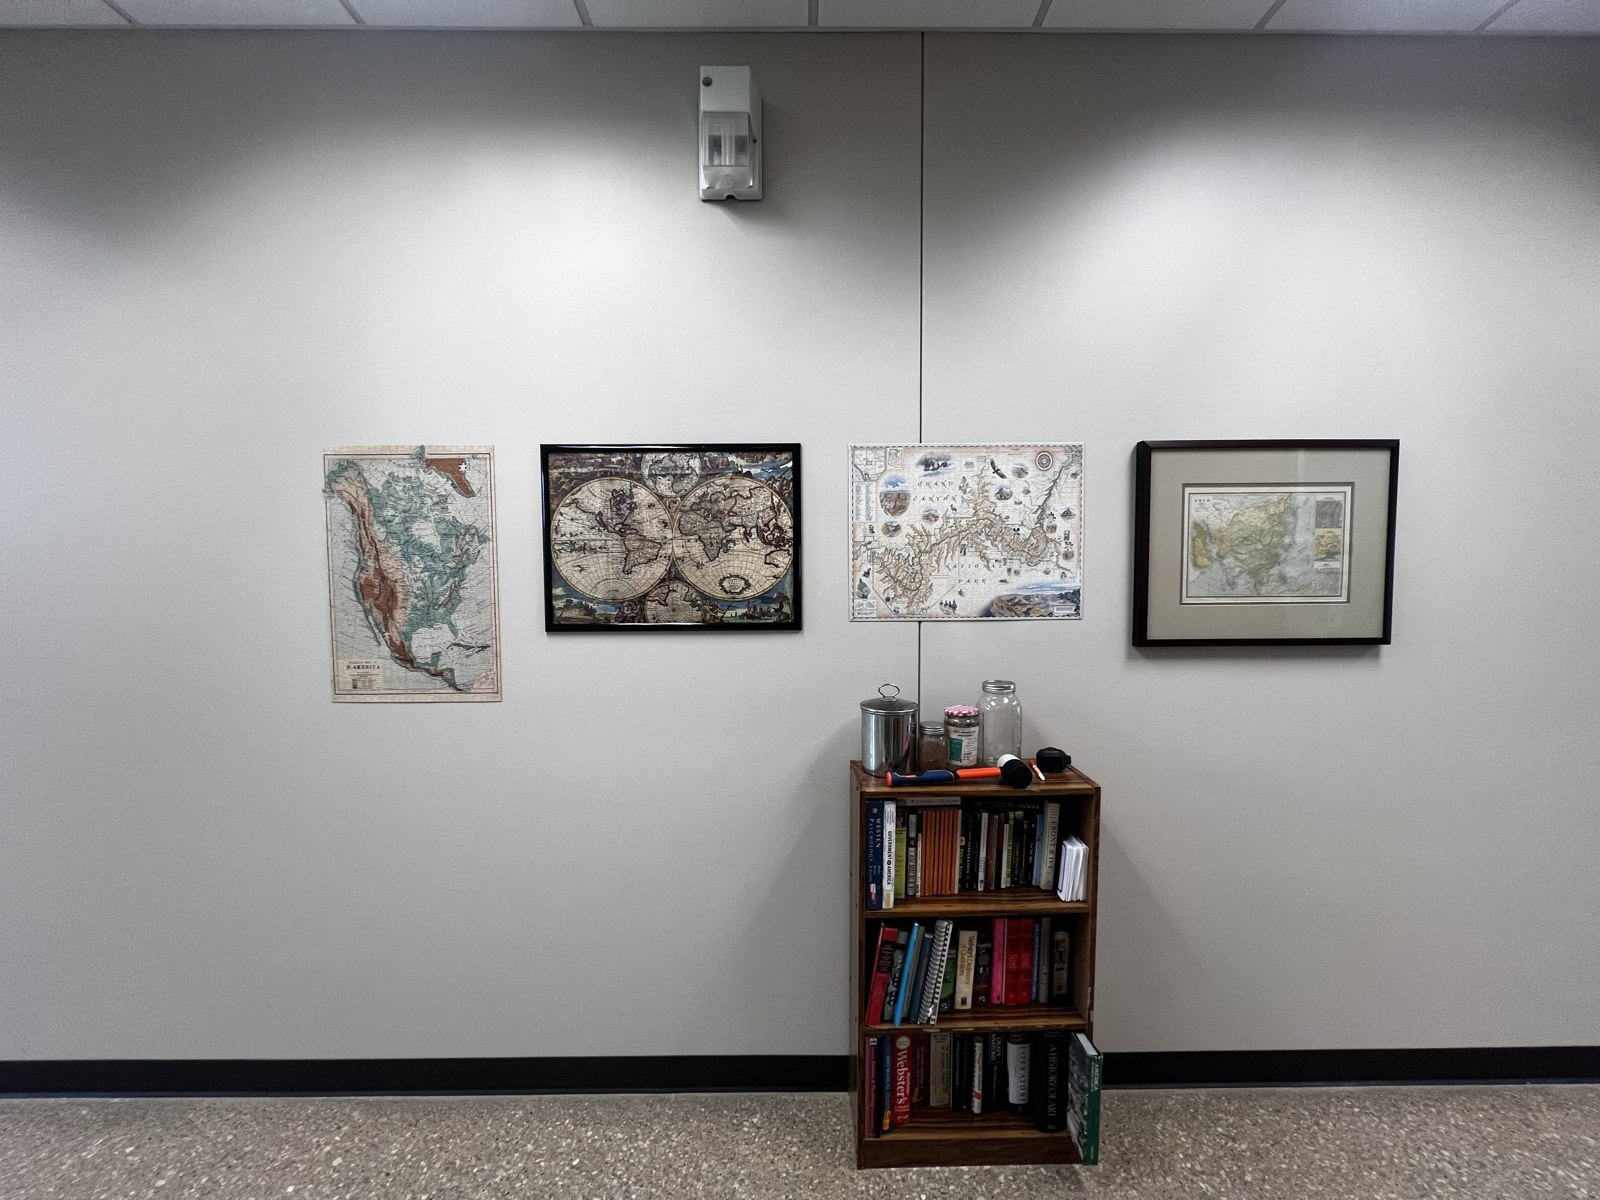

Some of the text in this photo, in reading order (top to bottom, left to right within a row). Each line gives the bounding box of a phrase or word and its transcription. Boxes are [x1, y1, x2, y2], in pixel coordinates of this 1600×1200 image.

[1049, 820, 1058, 847] EBONY
[896, 1049, 909, 1105] Webster's
[1019, 1045, 1027, 1103] LITERATURE
[1047, 1043, 1058, 1117] A HISTORY OF ART
